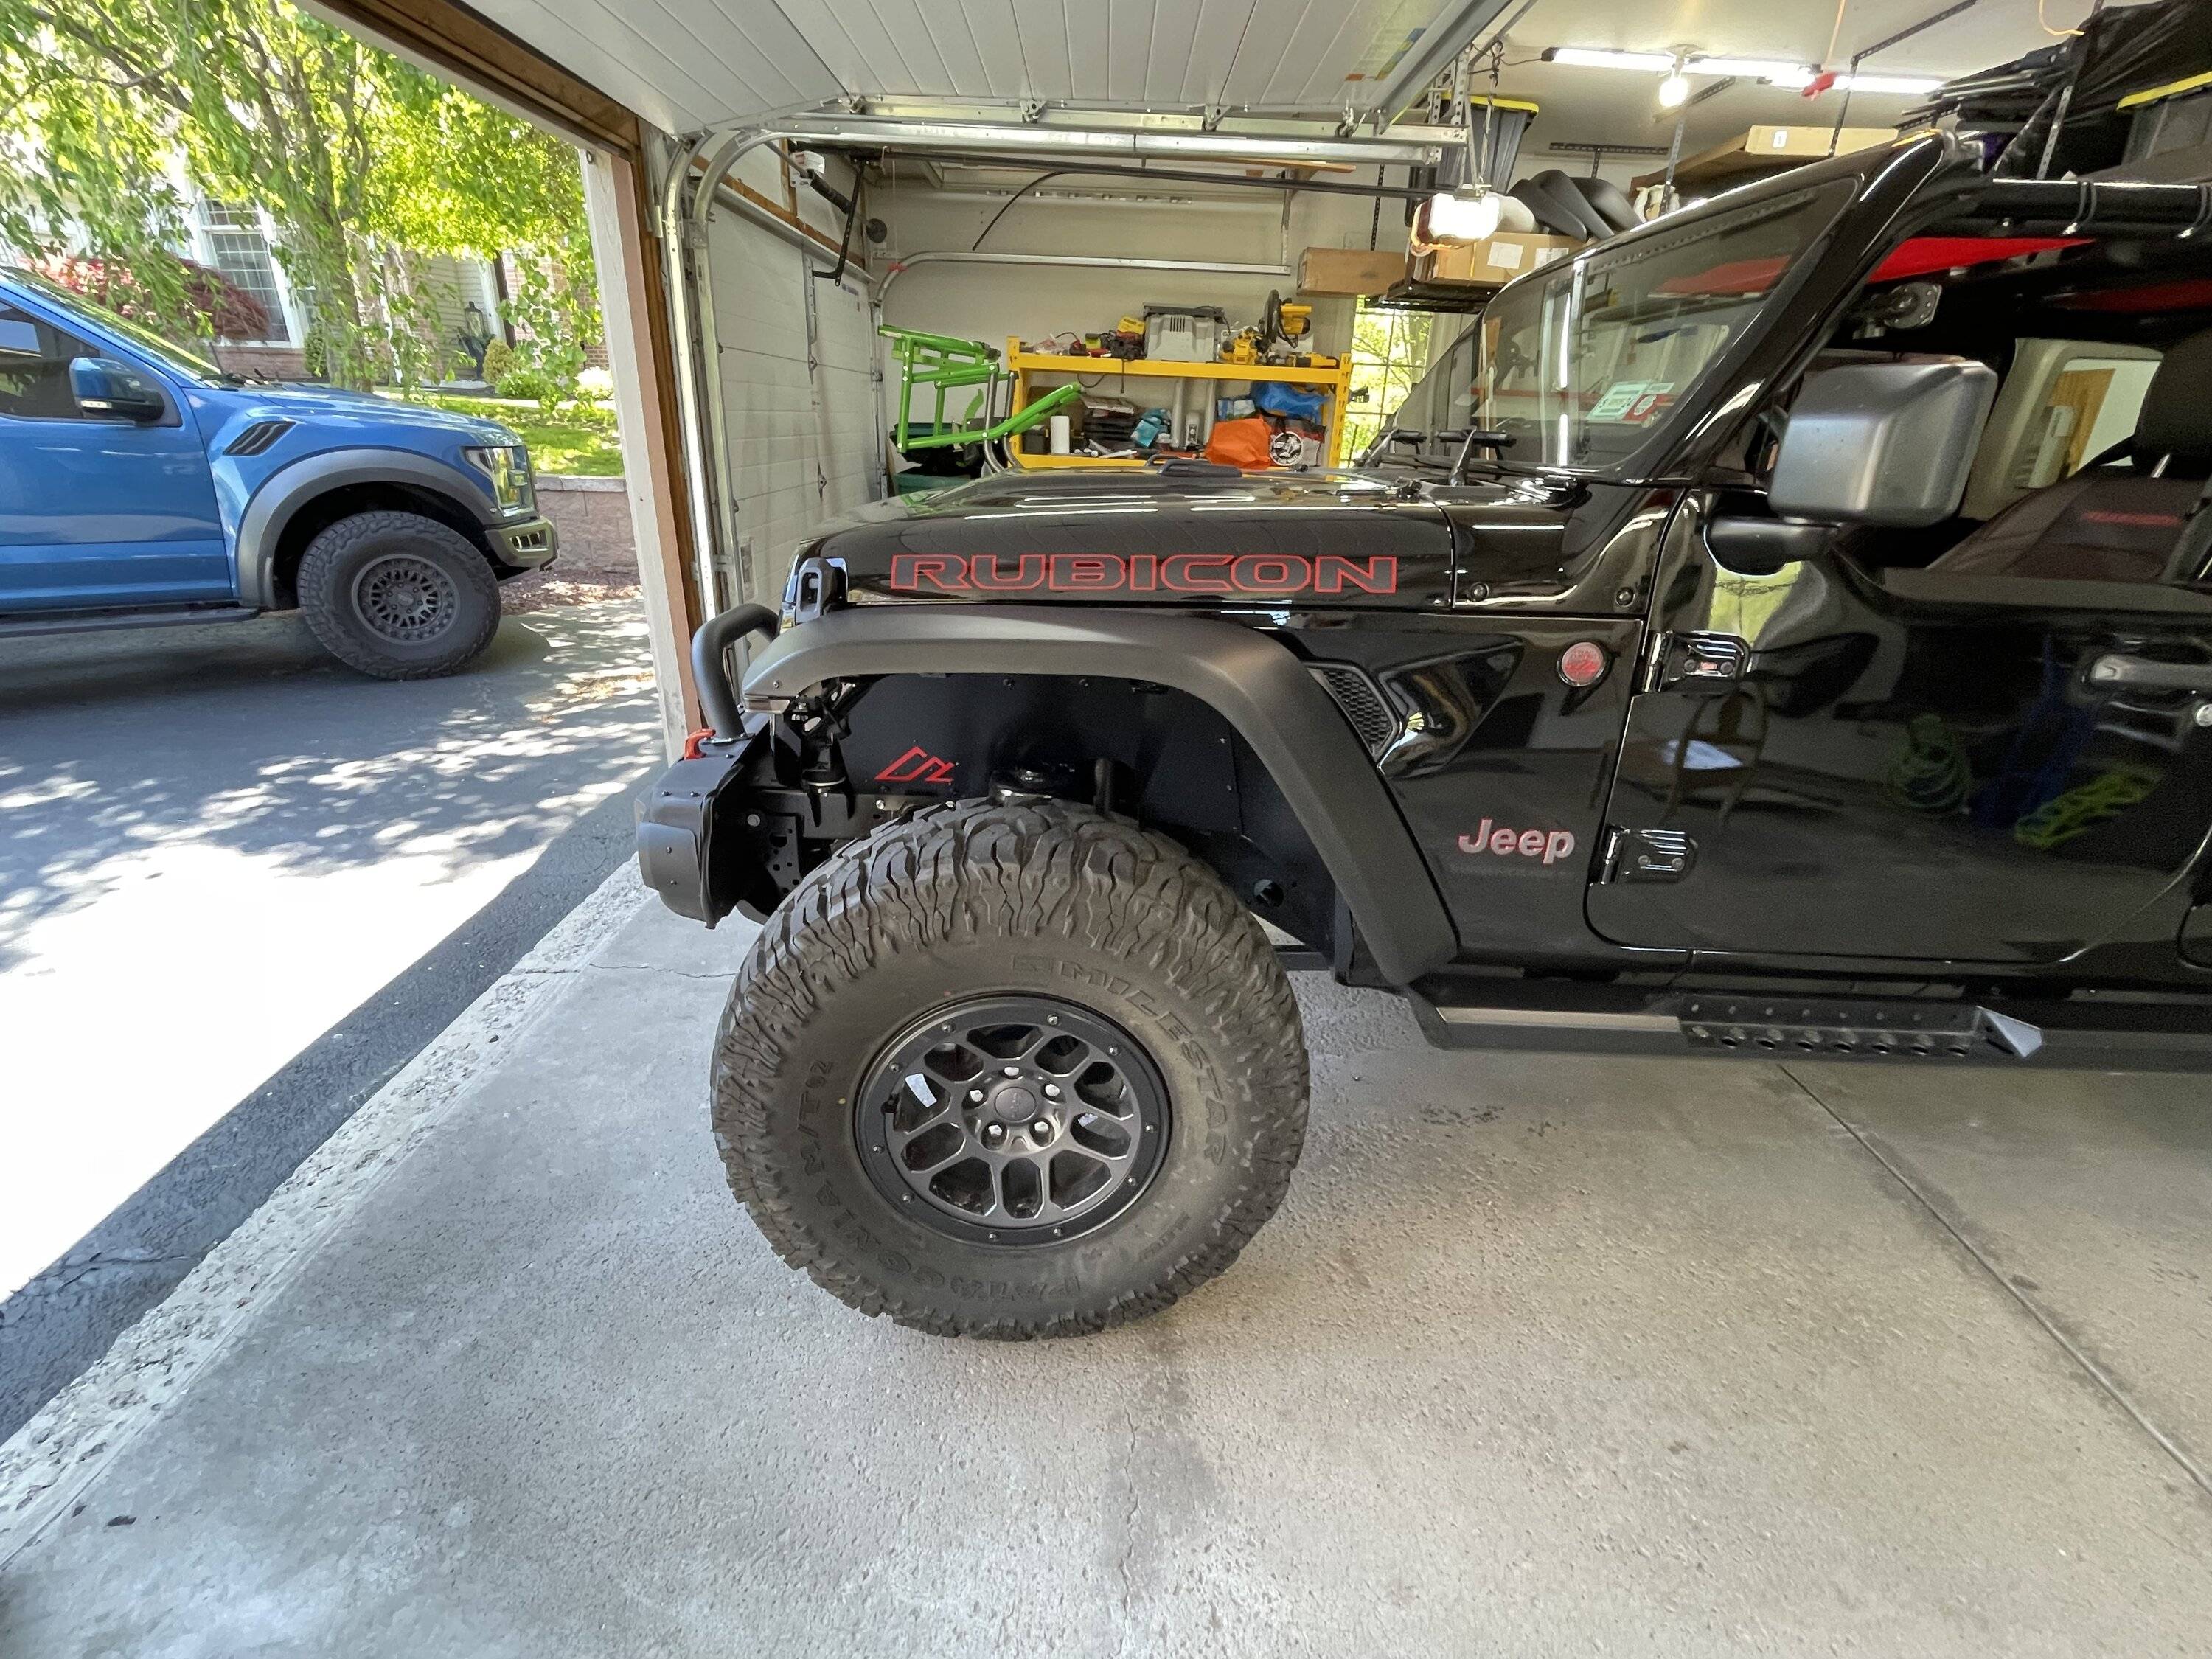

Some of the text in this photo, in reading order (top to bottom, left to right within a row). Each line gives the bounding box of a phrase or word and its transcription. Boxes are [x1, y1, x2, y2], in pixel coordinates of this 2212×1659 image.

[890, 554, 1397, 594] RUBICON
[1458, 818, 1576, 865] Jeep
[1060, 960, 1228, 1165] MILESTAR
